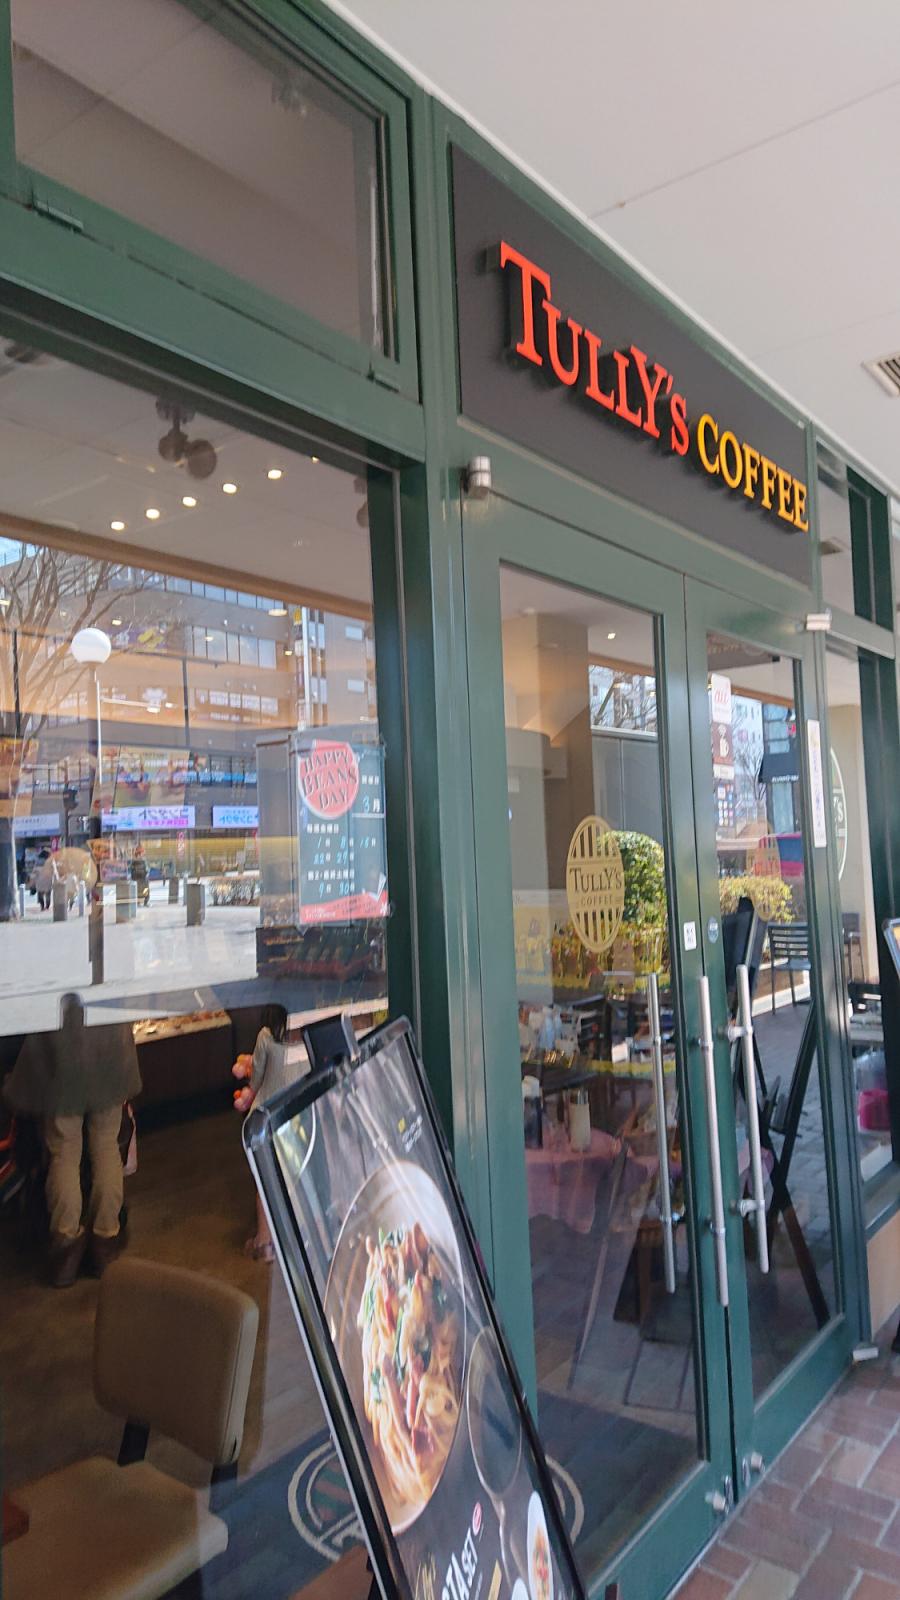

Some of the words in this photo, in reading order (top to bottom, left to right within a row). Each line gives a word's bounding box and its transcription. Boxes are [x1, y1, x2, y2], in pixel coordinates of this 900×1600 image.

[698, 414, 809, 532] COFFEE
[304, 750, 350, 773] HAPPY
[302, 767, 358, 797] BEANS
[319, 787, 349, 809] DAY
[569, 867, 622, 893] TULLY'S
